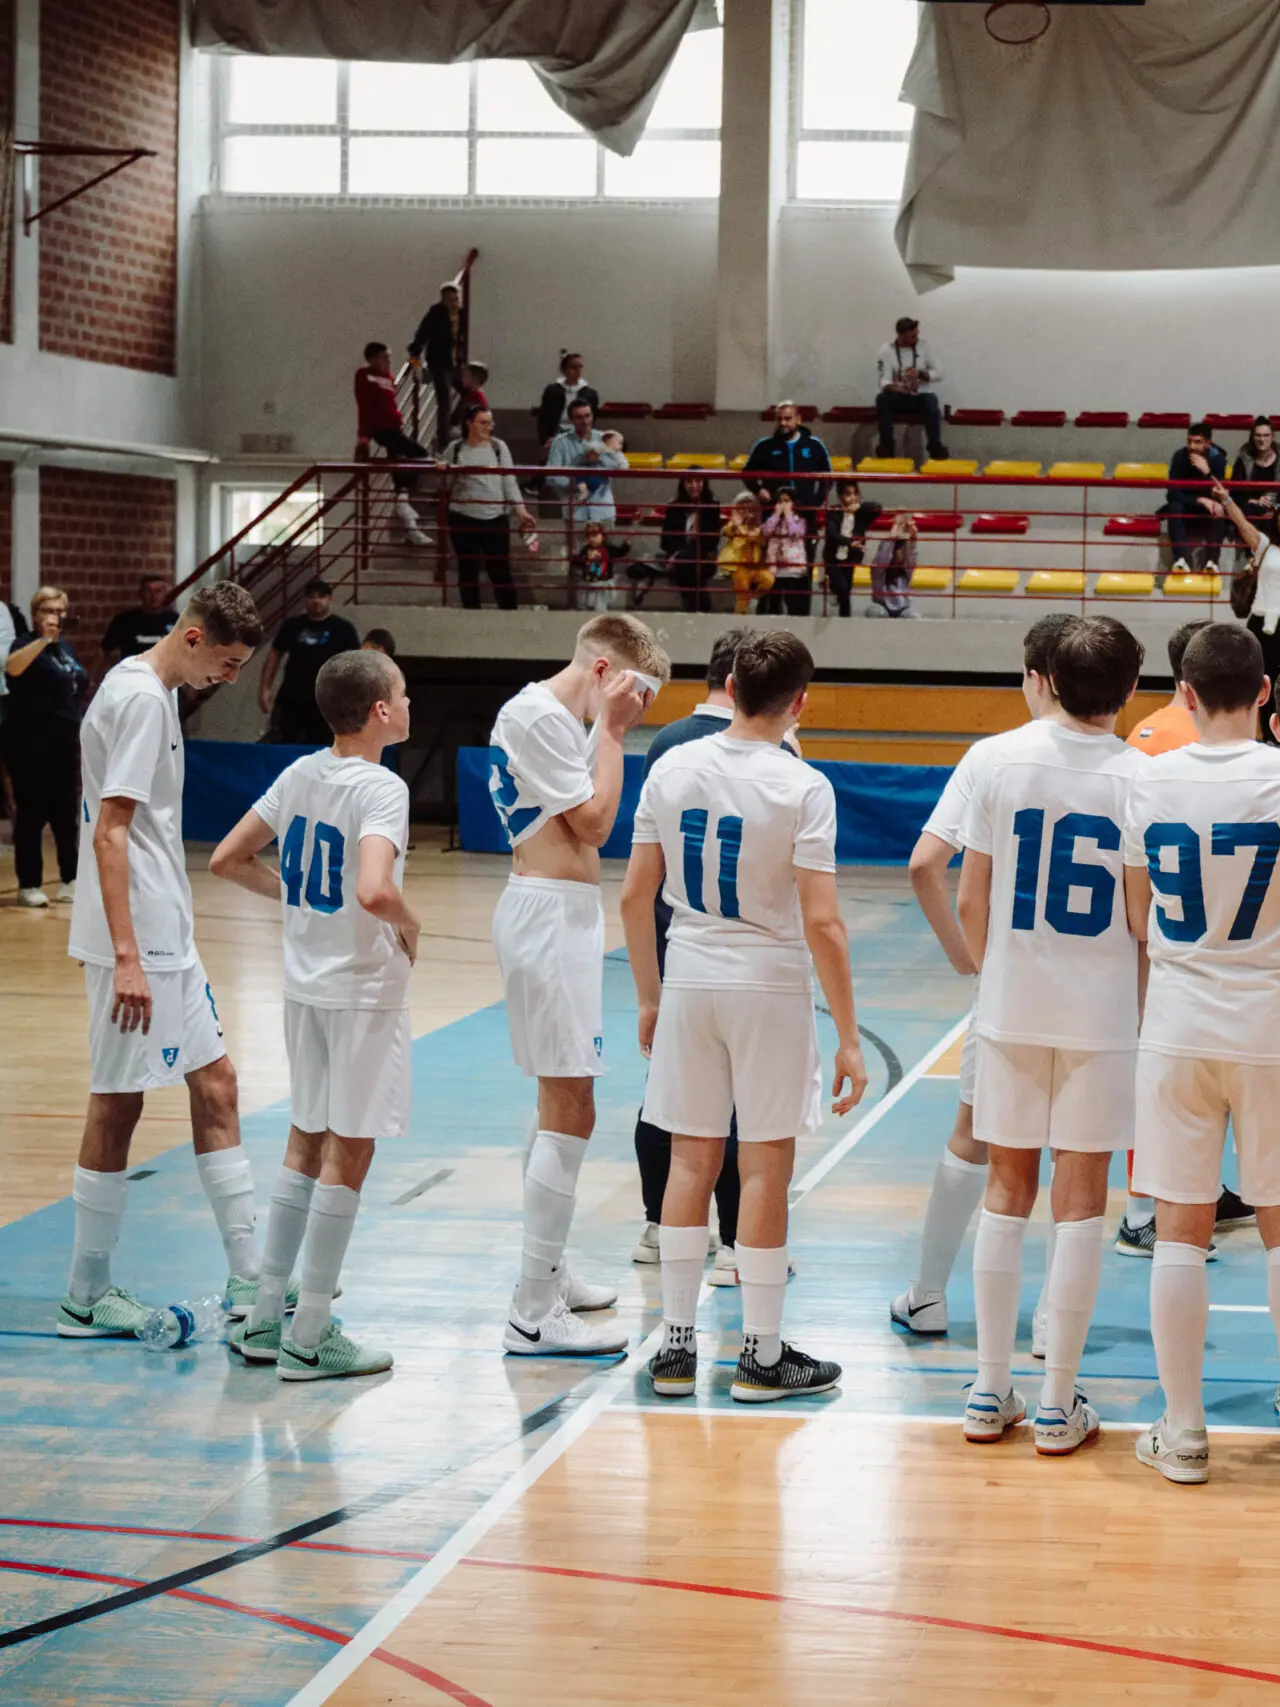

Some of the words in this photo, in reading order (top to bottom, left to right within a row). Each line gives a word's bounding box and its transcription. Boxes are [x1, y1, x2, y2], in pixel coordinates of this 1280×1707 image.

[280, 815, 345, 915] 40
[680, 808, 744, 918] 11
[1012, 808, 1123, 937] 16
